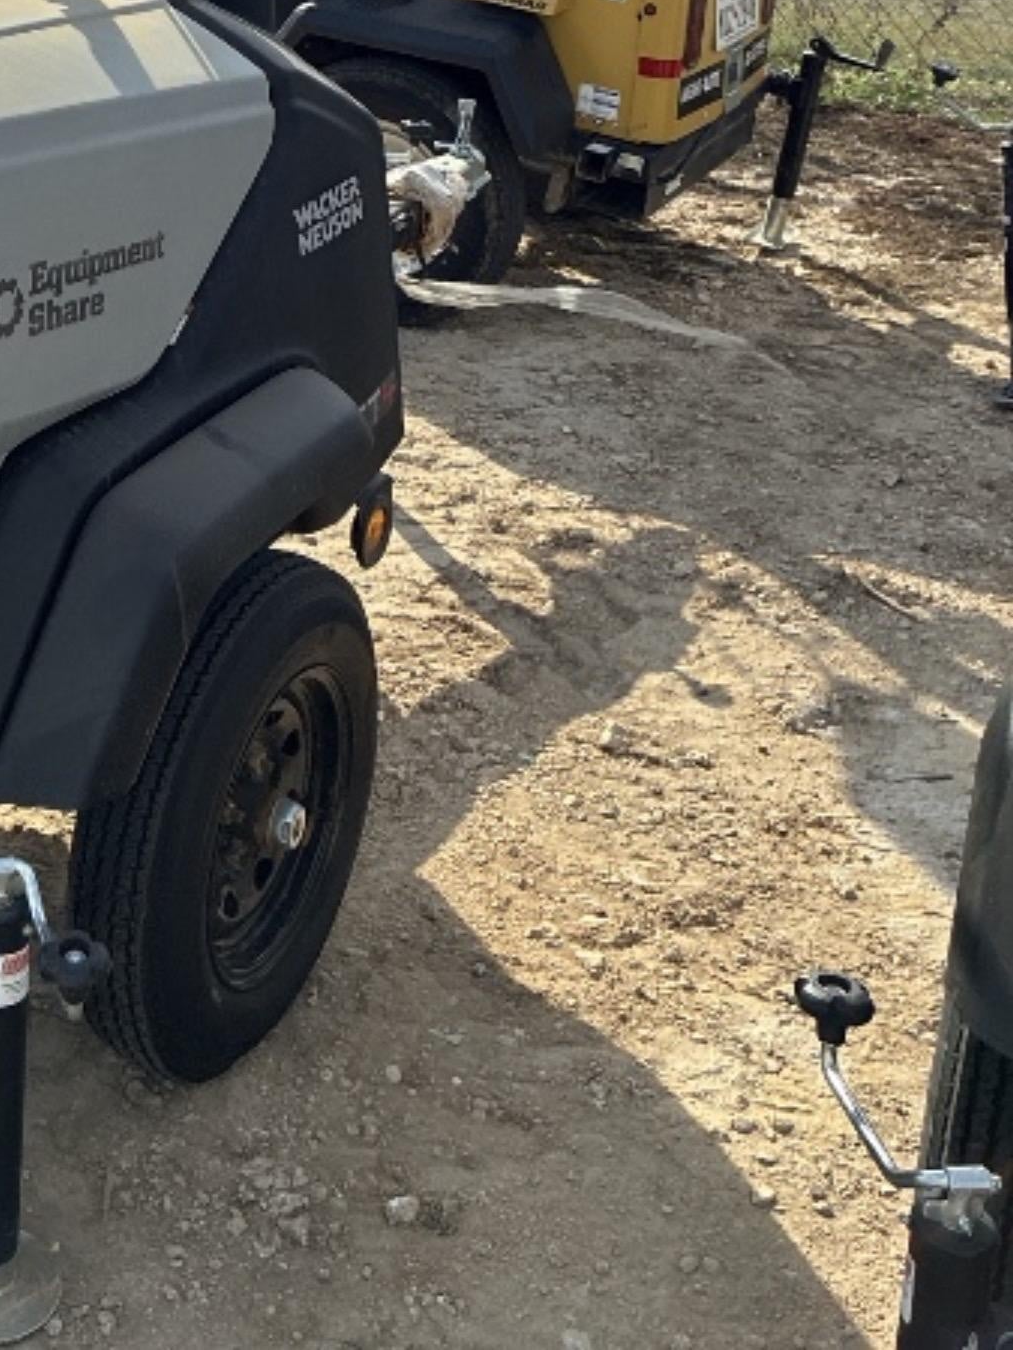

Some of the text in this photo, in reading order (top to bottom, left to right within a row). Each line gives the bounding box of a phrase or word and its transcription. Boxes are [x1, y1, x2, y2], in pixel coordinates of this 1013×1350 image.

[293, 175, 362, 229] WACKER
[298, 200, 364, 256] NEUSON
[29, 231, 165, 296] Equipment
[29, 290, 105, 337] Share
